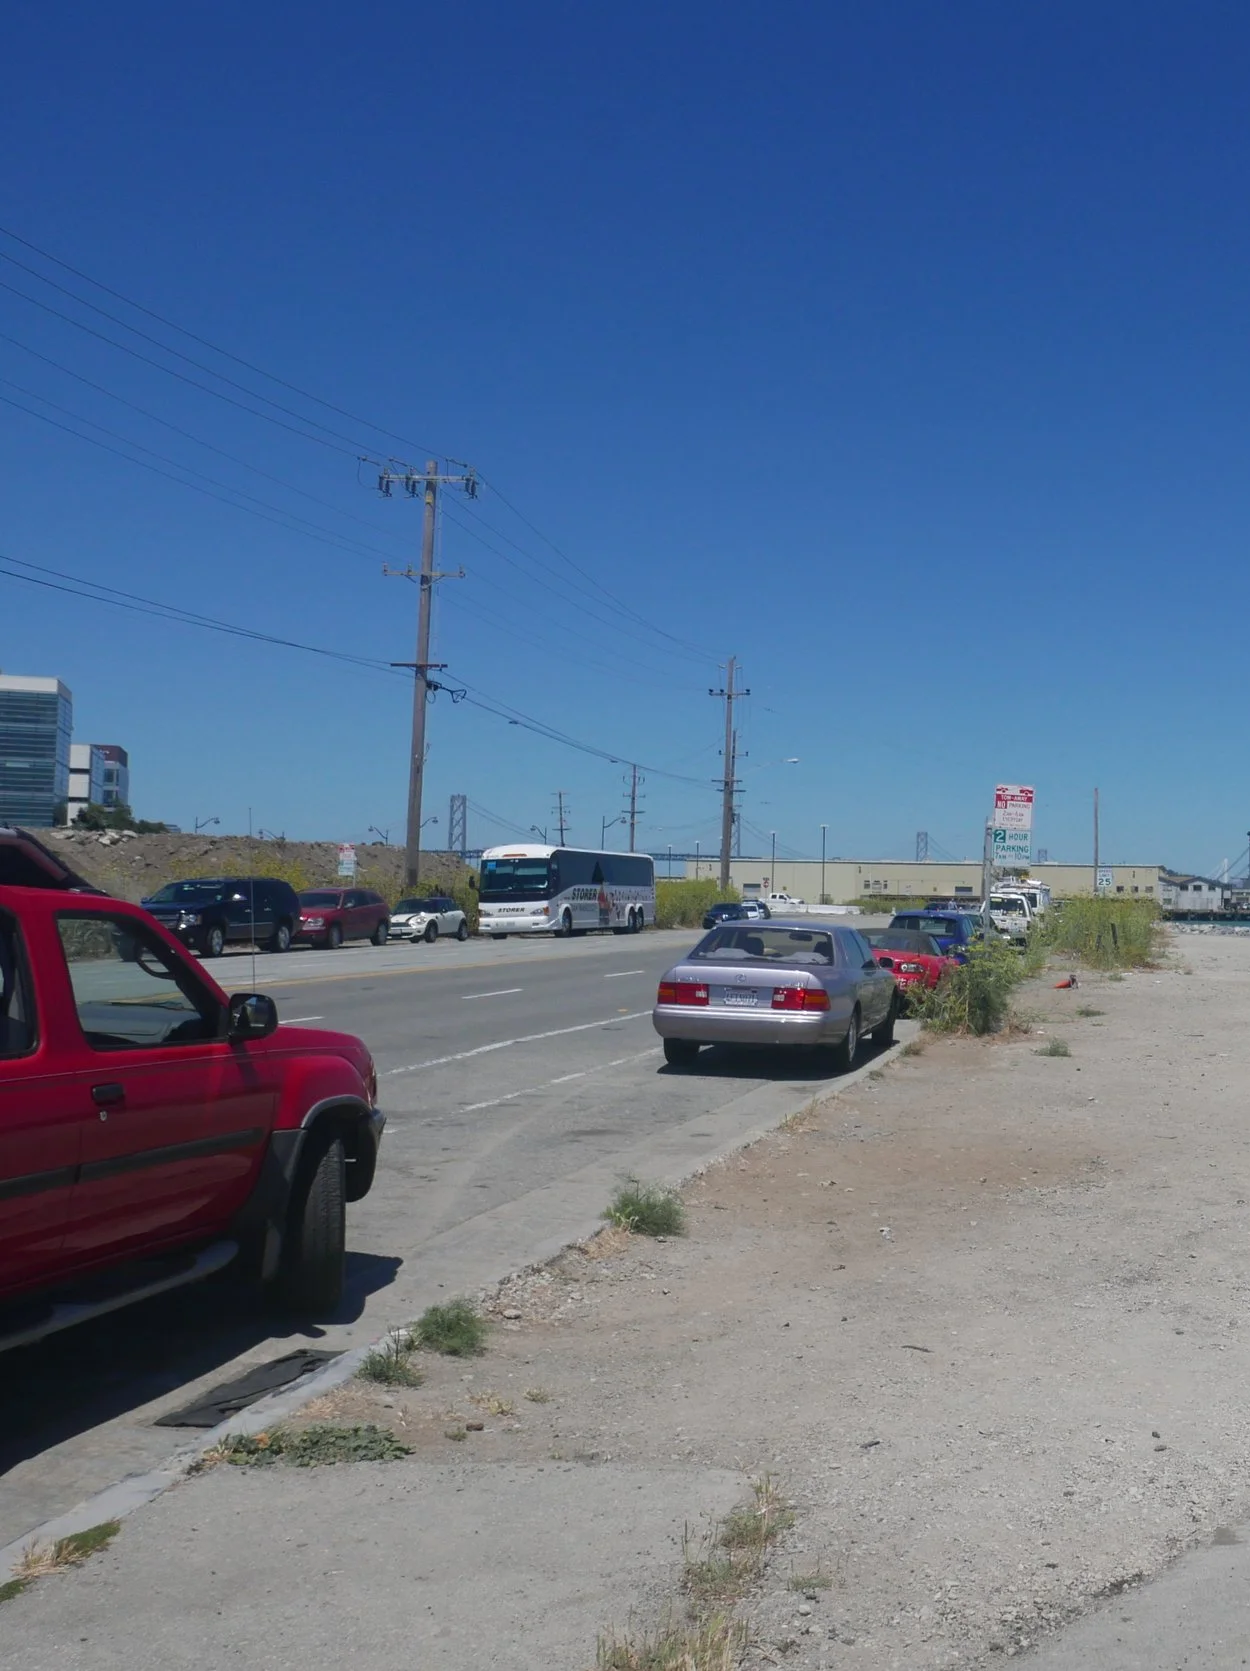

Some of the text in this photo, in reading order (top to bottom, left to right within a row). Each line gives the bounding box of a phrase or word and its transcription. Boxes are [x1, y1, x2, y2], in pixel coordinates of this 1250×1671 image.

[997, 800, 1006, 809] NO
[996, 830, 1028, 842] 2 HOUR
[996, 844, 1029, 853] PARKING
[1098, 878, 1111, 886] 25
[572, 888, 597, 900] STORER
